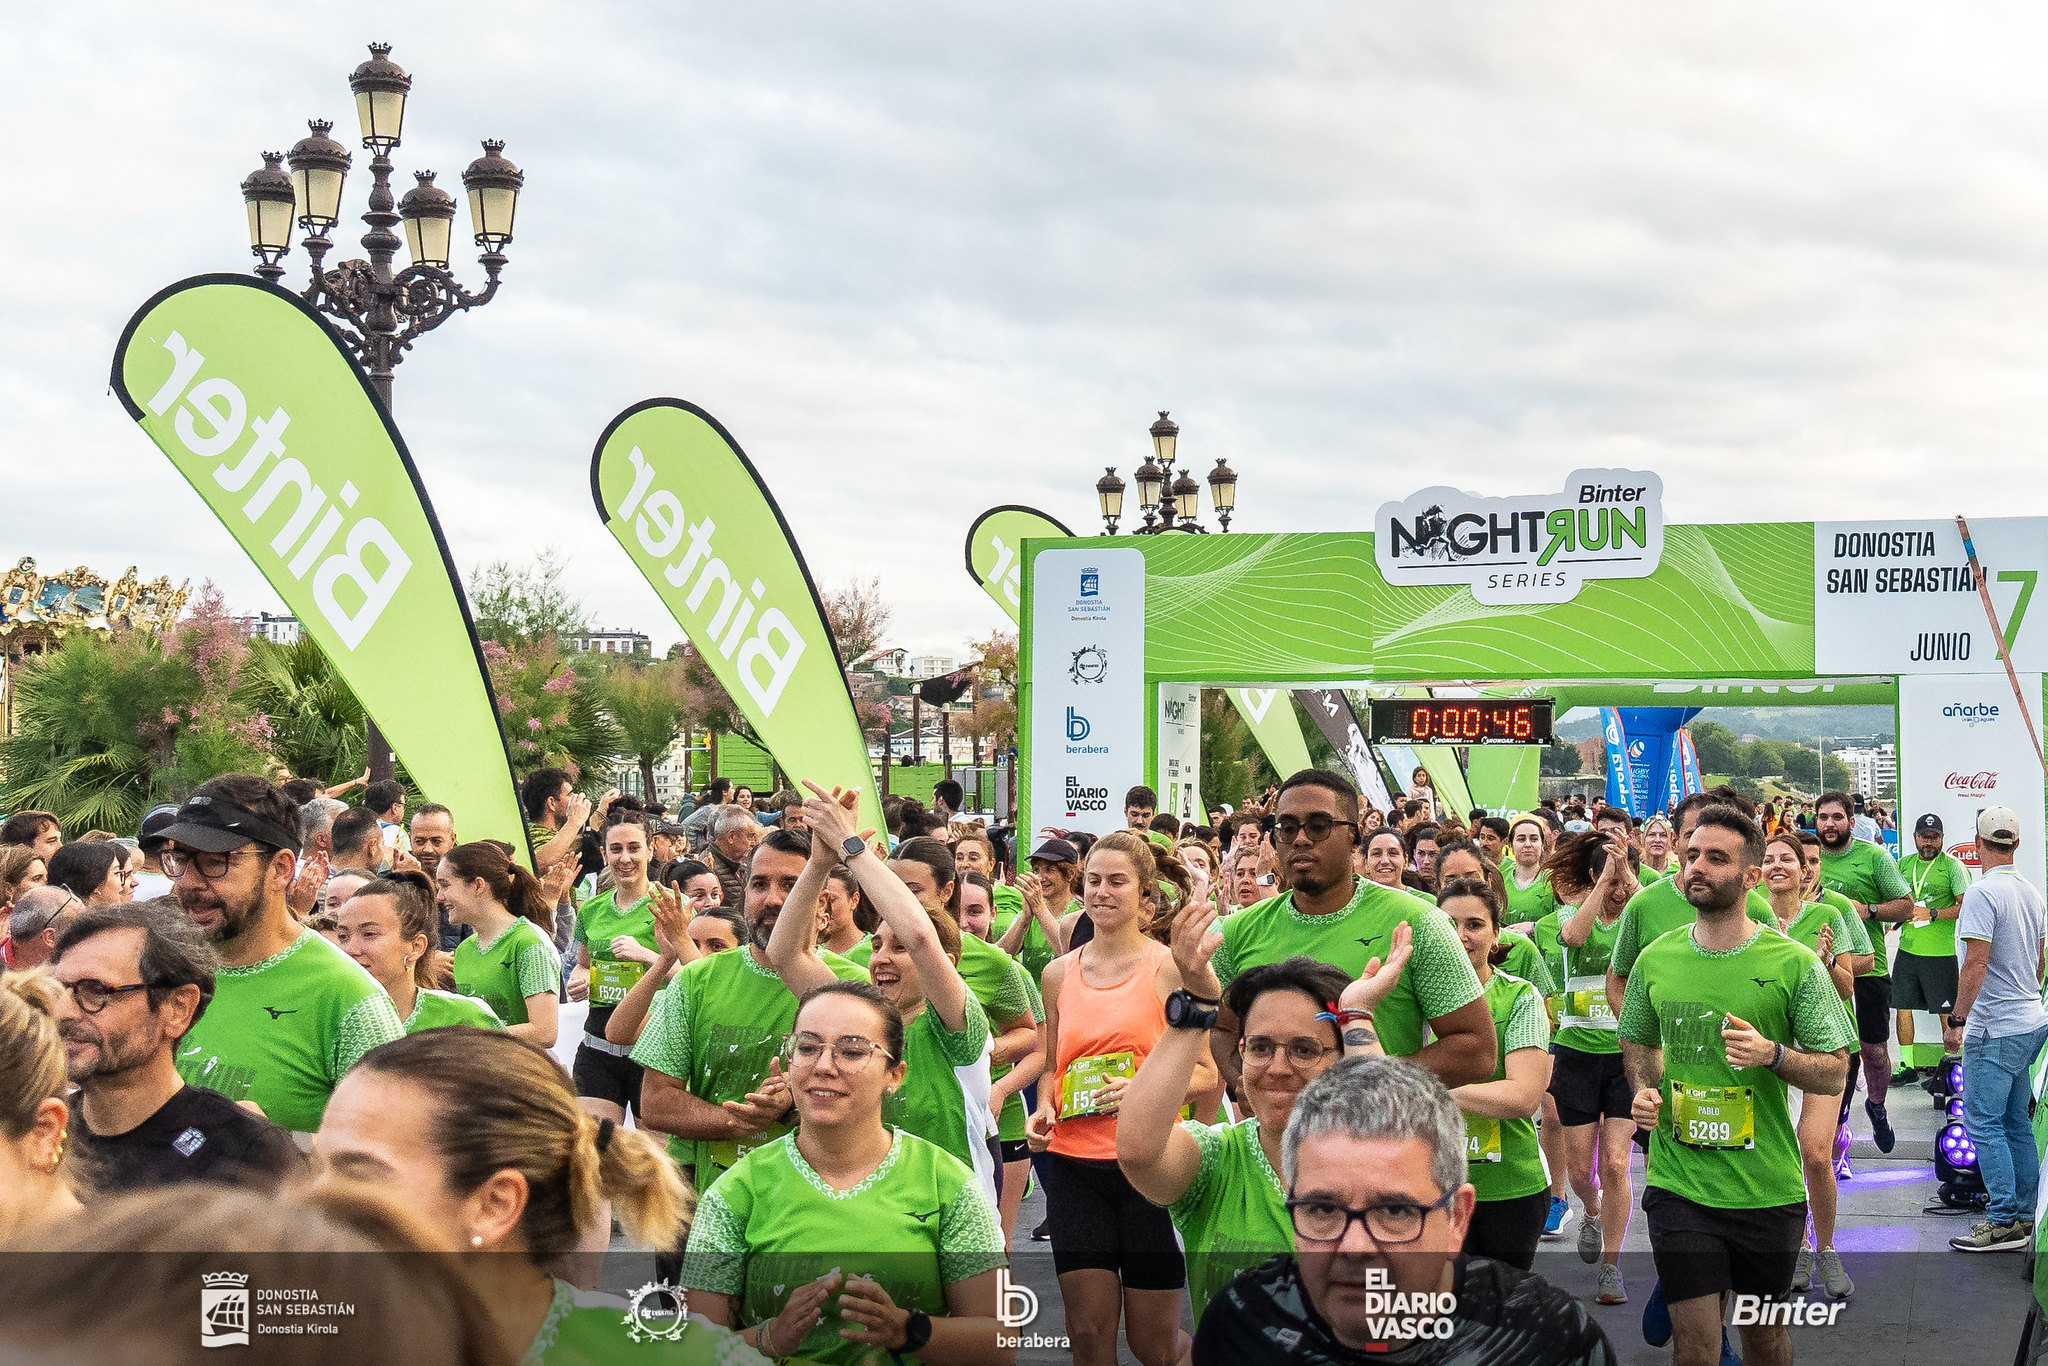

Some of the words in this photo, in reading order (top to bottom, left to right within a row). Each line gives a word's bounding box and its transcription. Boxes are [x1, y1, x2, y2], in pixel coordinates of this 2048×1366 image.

[1579, 485, 1646, 504] Binter
[1834, 532, 1935, 558] DONOSTIA
[1487, 572, 1566, 589] SERIES
[1827, 568, 1868, 593] SAN
[1995, 570, 2038, 660] 7
[1910, 632, 1971, 661] JUNIO
[1943, 702, 1999, 717] añarbe
[1412, 708, 1532, 737] 0:00:46
[1066, 745, 1109, 753] berabera
[1065, 776, 1080, 787] EL
[1065, 787, 1109, 798] DIARIO
[1066, 800, 1107, 811] VASCO
[1084, 1075, 1101, 1084] SARA
[1698, 1106, 1720, 1115] PABLO
[1689, 1120, 1730, 1141] 5289
